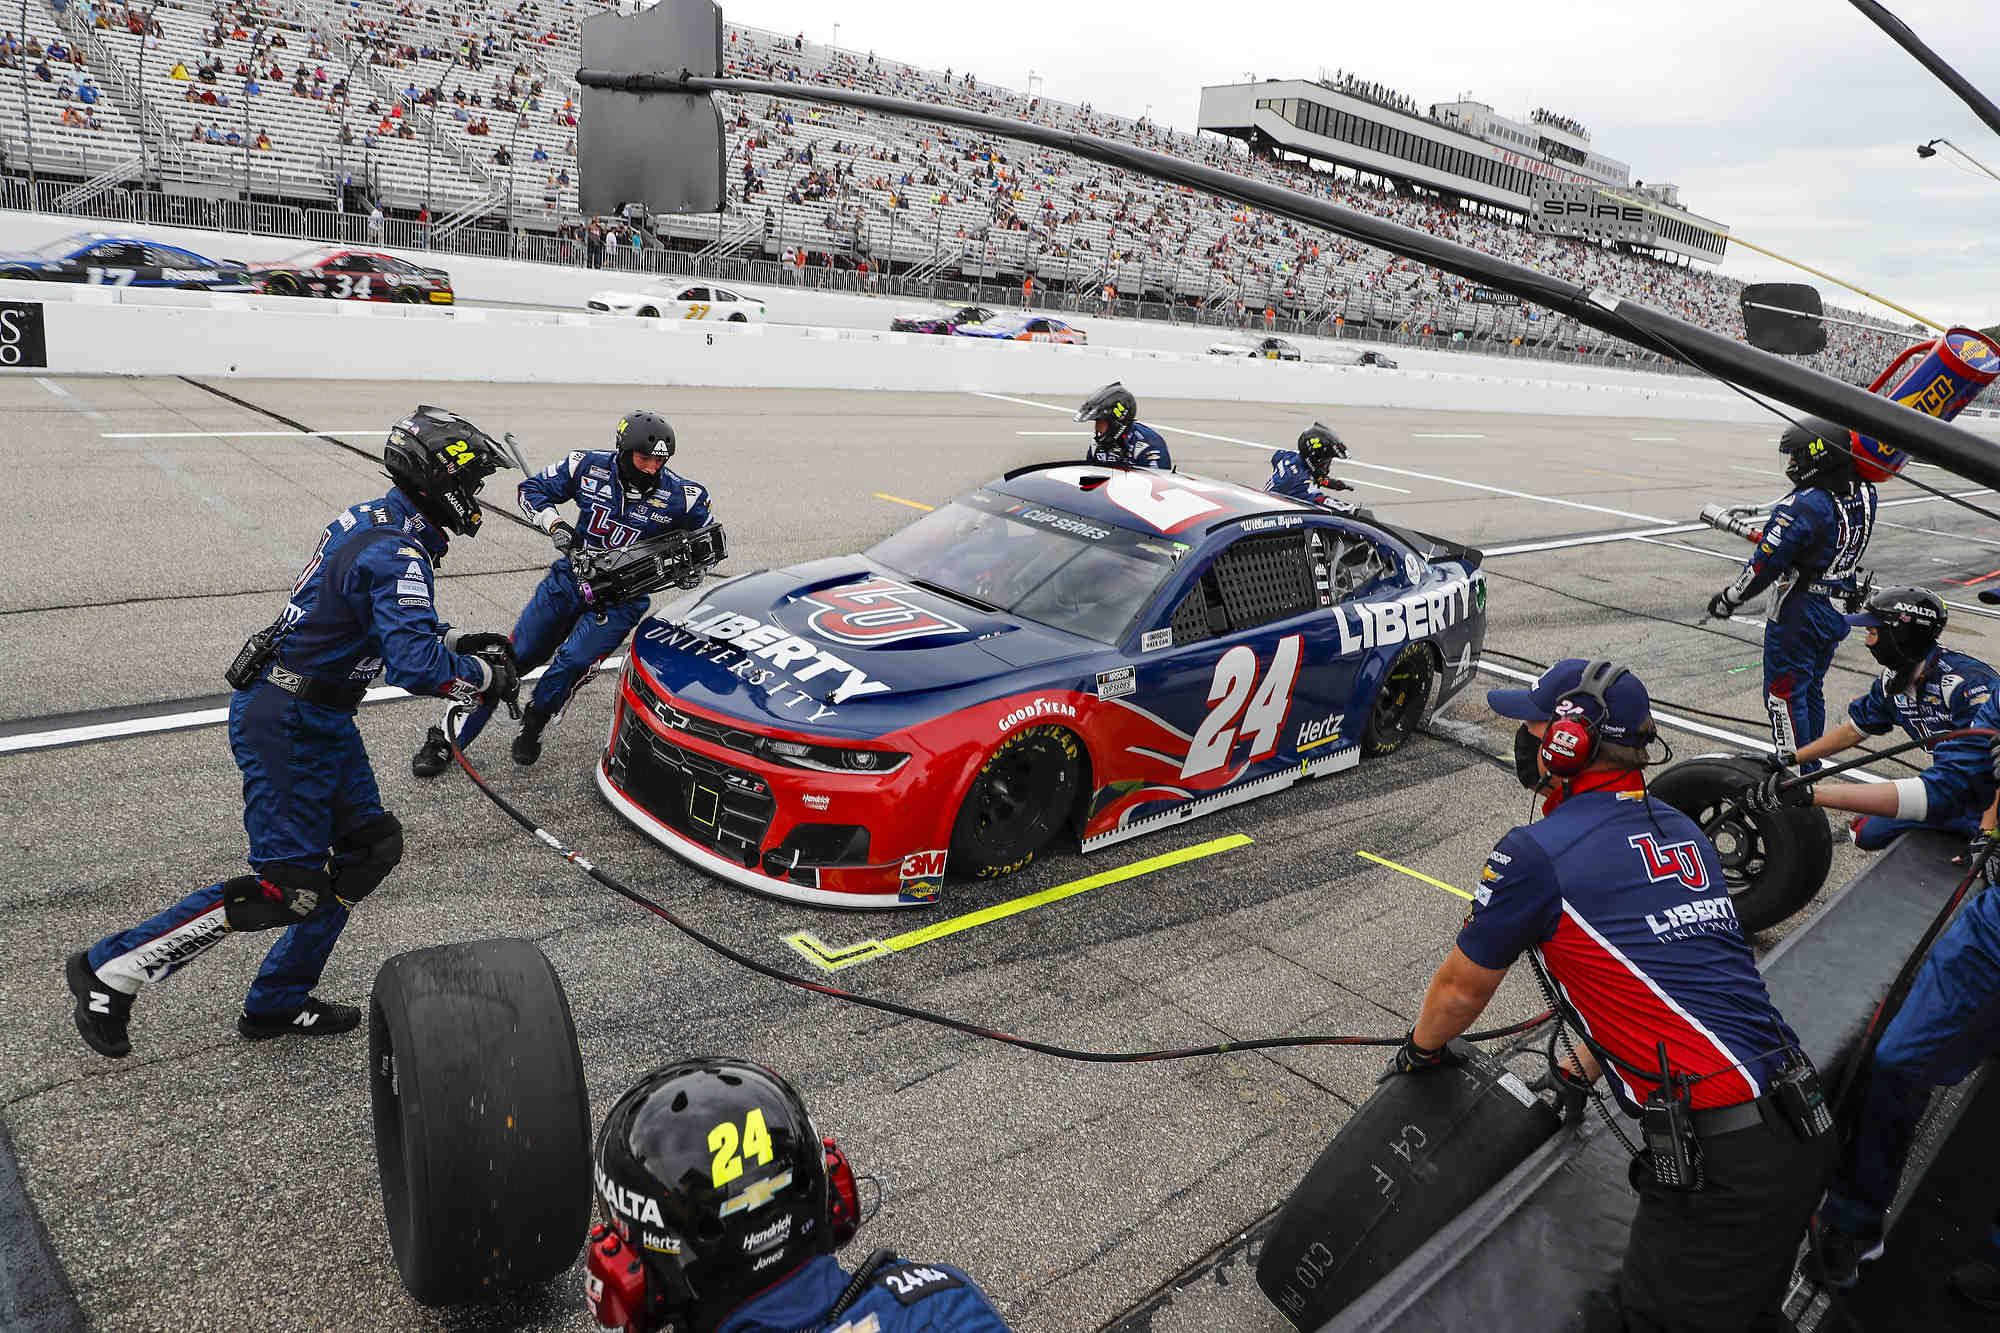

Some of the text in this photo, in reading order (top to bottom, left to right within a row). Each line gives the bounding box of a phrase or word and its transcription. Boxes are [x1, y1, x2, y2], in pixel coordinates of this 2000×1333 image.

[1503, 151, 1521, 167] NEW
[1524, 158, 1566, 183] HAMPSHIRE
[1543, 200, 1643, 222] SPIRE
[331, 274, 373, 300] 34
[706, 333, 713, 345] 5
[444, 440, 476, 466] 24
[1808, 438, 1825, 455] 24
[444, 492, 465, 518] AXALTA
[1023, 509, 1110, 541] CUP SERIES
[1241, 515, 1303, 531] William Byron
[1332, 576, 1470, 655] LIBERTY
[1893, 602, 1937, 618] AXALTA
[687, 604, 892, 705] LIBERTY
[644, 625, 838, 723] UNIVERSITY
[998, 697, 1077, 732] GOODYEAR
[1180, 632, 1304, 781] 24
[1297, 713, 1345, 746] Hertz
[901, 852, 947, 878] 3M
[707, 1107, 774, 1189] 24
[642, 1231, 681, 1251] Hertz
[742, 1213, 793, 1250] Hendrick
